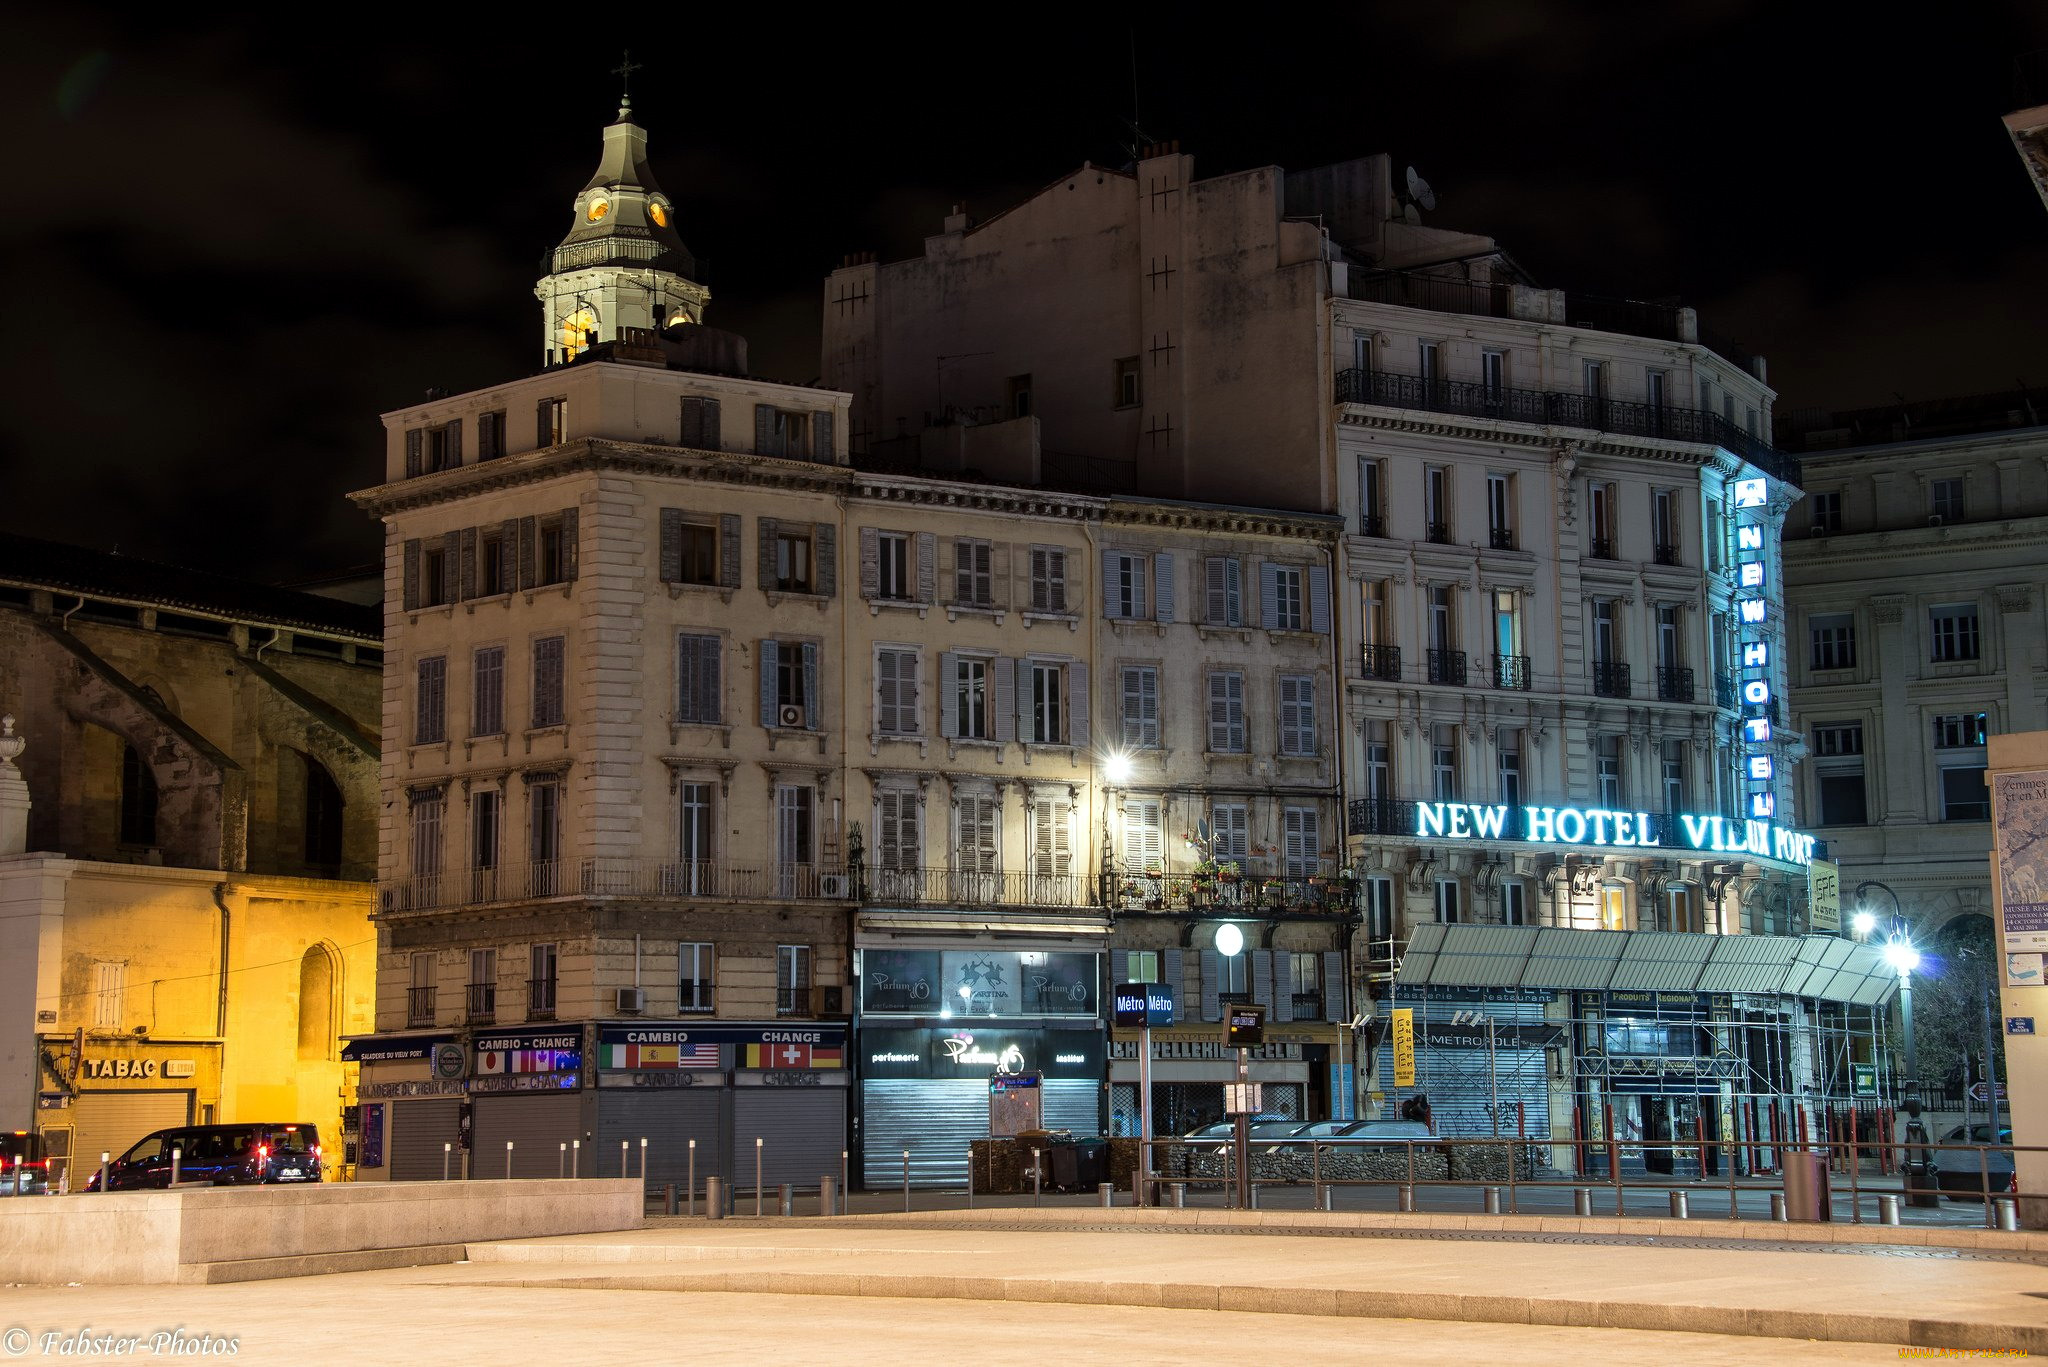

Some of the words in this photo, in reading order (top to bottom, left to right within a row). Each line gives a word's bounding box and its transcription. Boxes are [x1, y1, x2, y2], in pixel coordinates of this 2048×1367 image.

[1738, 526, 1764, 622] NEW
[1744, 643, 1776, 817] HOTEL
[2020, 793, 2032, 801] en
[1416, 802, 1508, 839] NEW
[1525, 806, 1660, 847] HOTEL
[1773, 826, 1816, 865] PORT
[872, 972, 911, 992] Parfum
[1031, 975, 1070, 993] Parfum
[1117, 995, 1145, 1012] Métro
[1148, 995, 1172, 1011] Métro
[1587, 994, 1593, 1002] 2
[478, 1038, 521, 1050] CAMBIO
[532, 1036, 576, 1049] CHANGE
[627, 1032, 688, 1043] CAMBIO
[762, 1032, 821, 1043] CHANGE
[361, 1052, 386, 1060] SALADERIE
[872, 1052, 920, 1063] parfumerie
[1056, 1053, 1085, 1063] institut
[87, 1058, 157, 1078] TABAC
[477, 1077, 518, 1091] CAMBIO
[633, 1072, 693, 1086] CAMBIO
